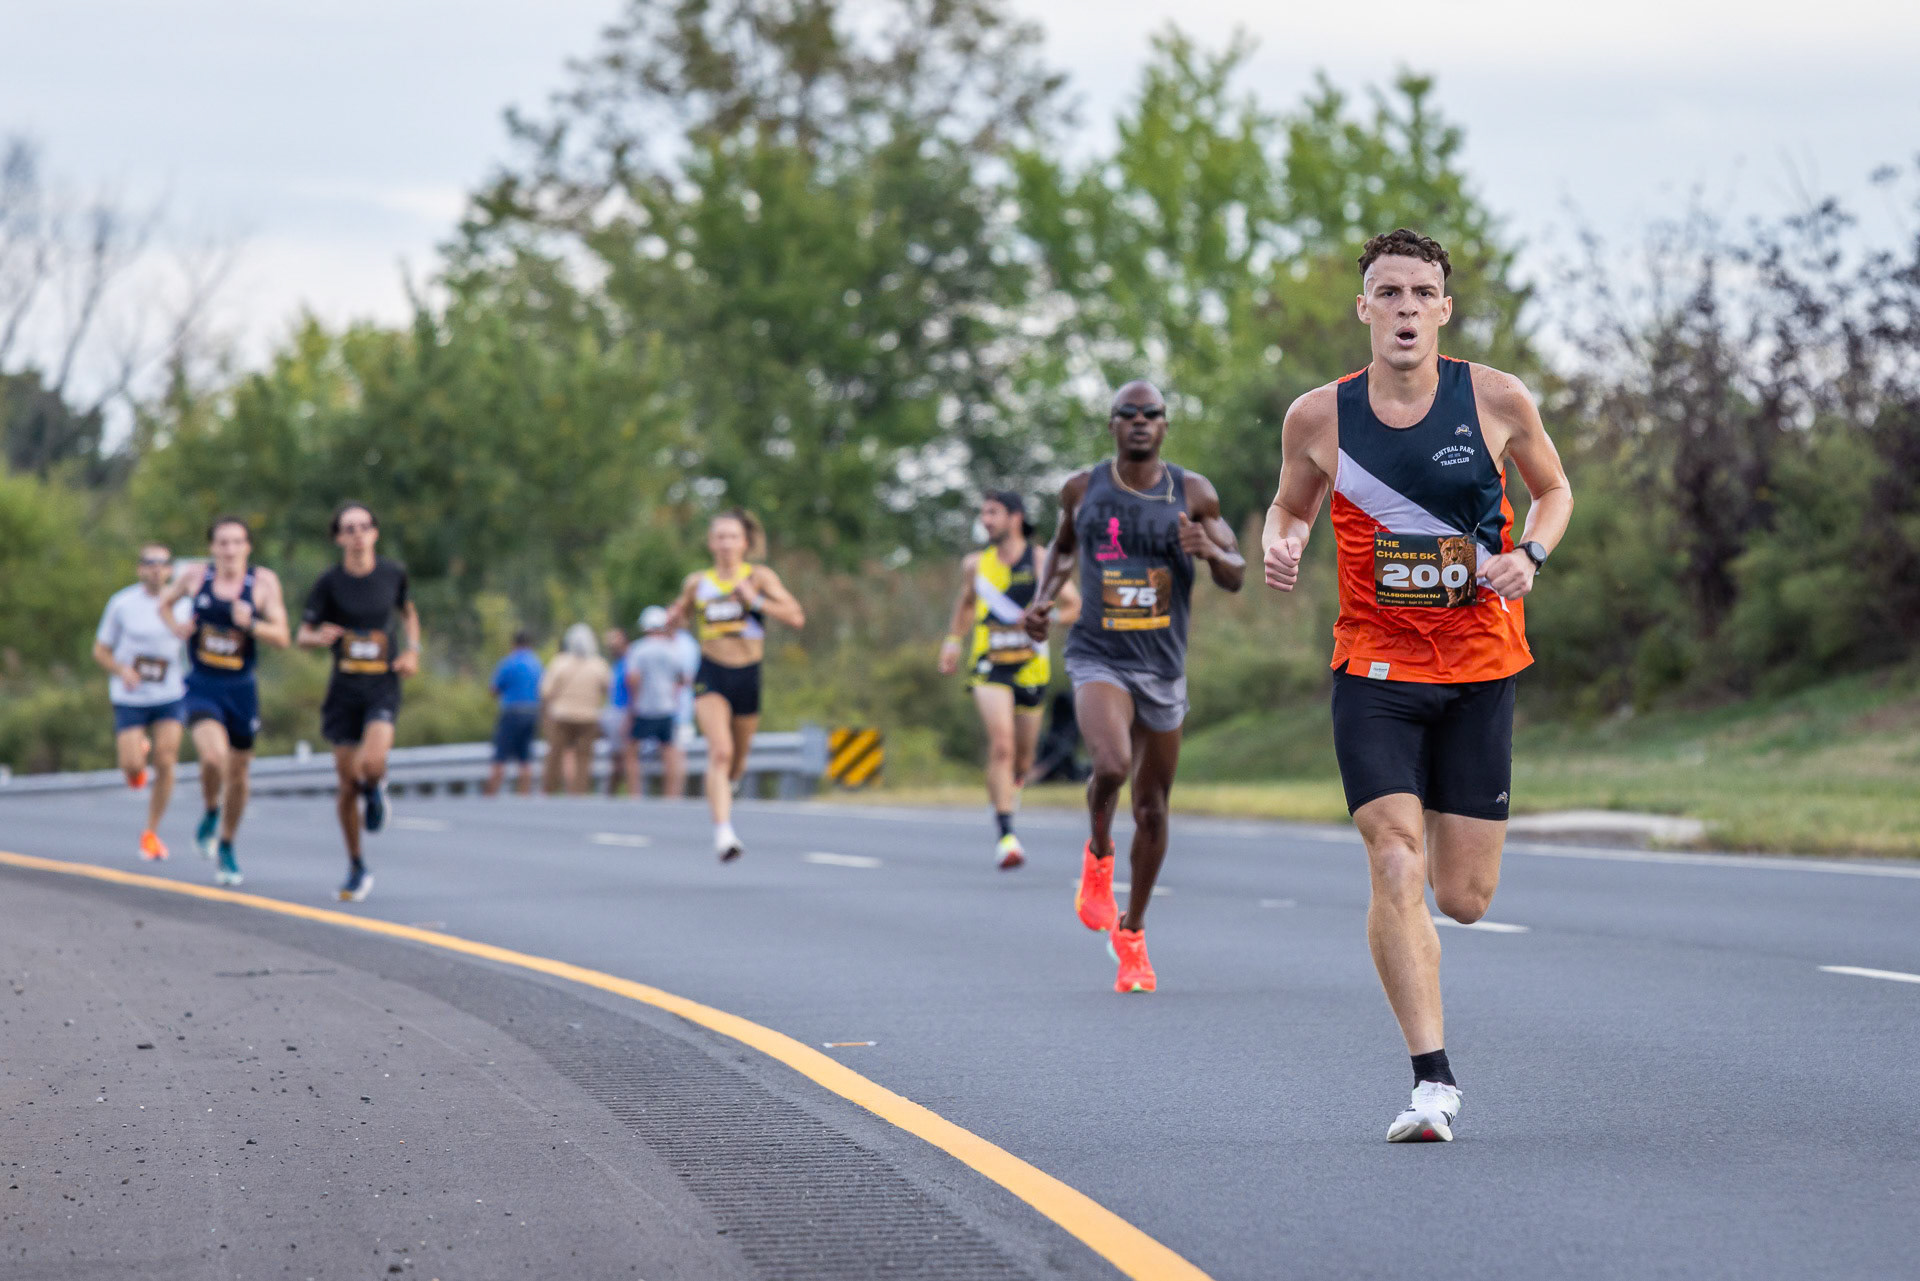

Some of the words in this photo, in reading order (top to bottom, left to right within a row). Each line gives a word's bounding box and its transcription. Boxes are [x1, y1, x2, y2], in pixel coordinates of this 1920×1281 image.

[1432, 446, 1458, 461] CENTRAL
[1460, 446, 1475, 455] PARK
[1376, 539, 1400, 548] THE
[1376, 550, 1418, 560] CHASE
[1382, 563, 1468, 588] 200
[1117, 586, 1157, 607] 75
